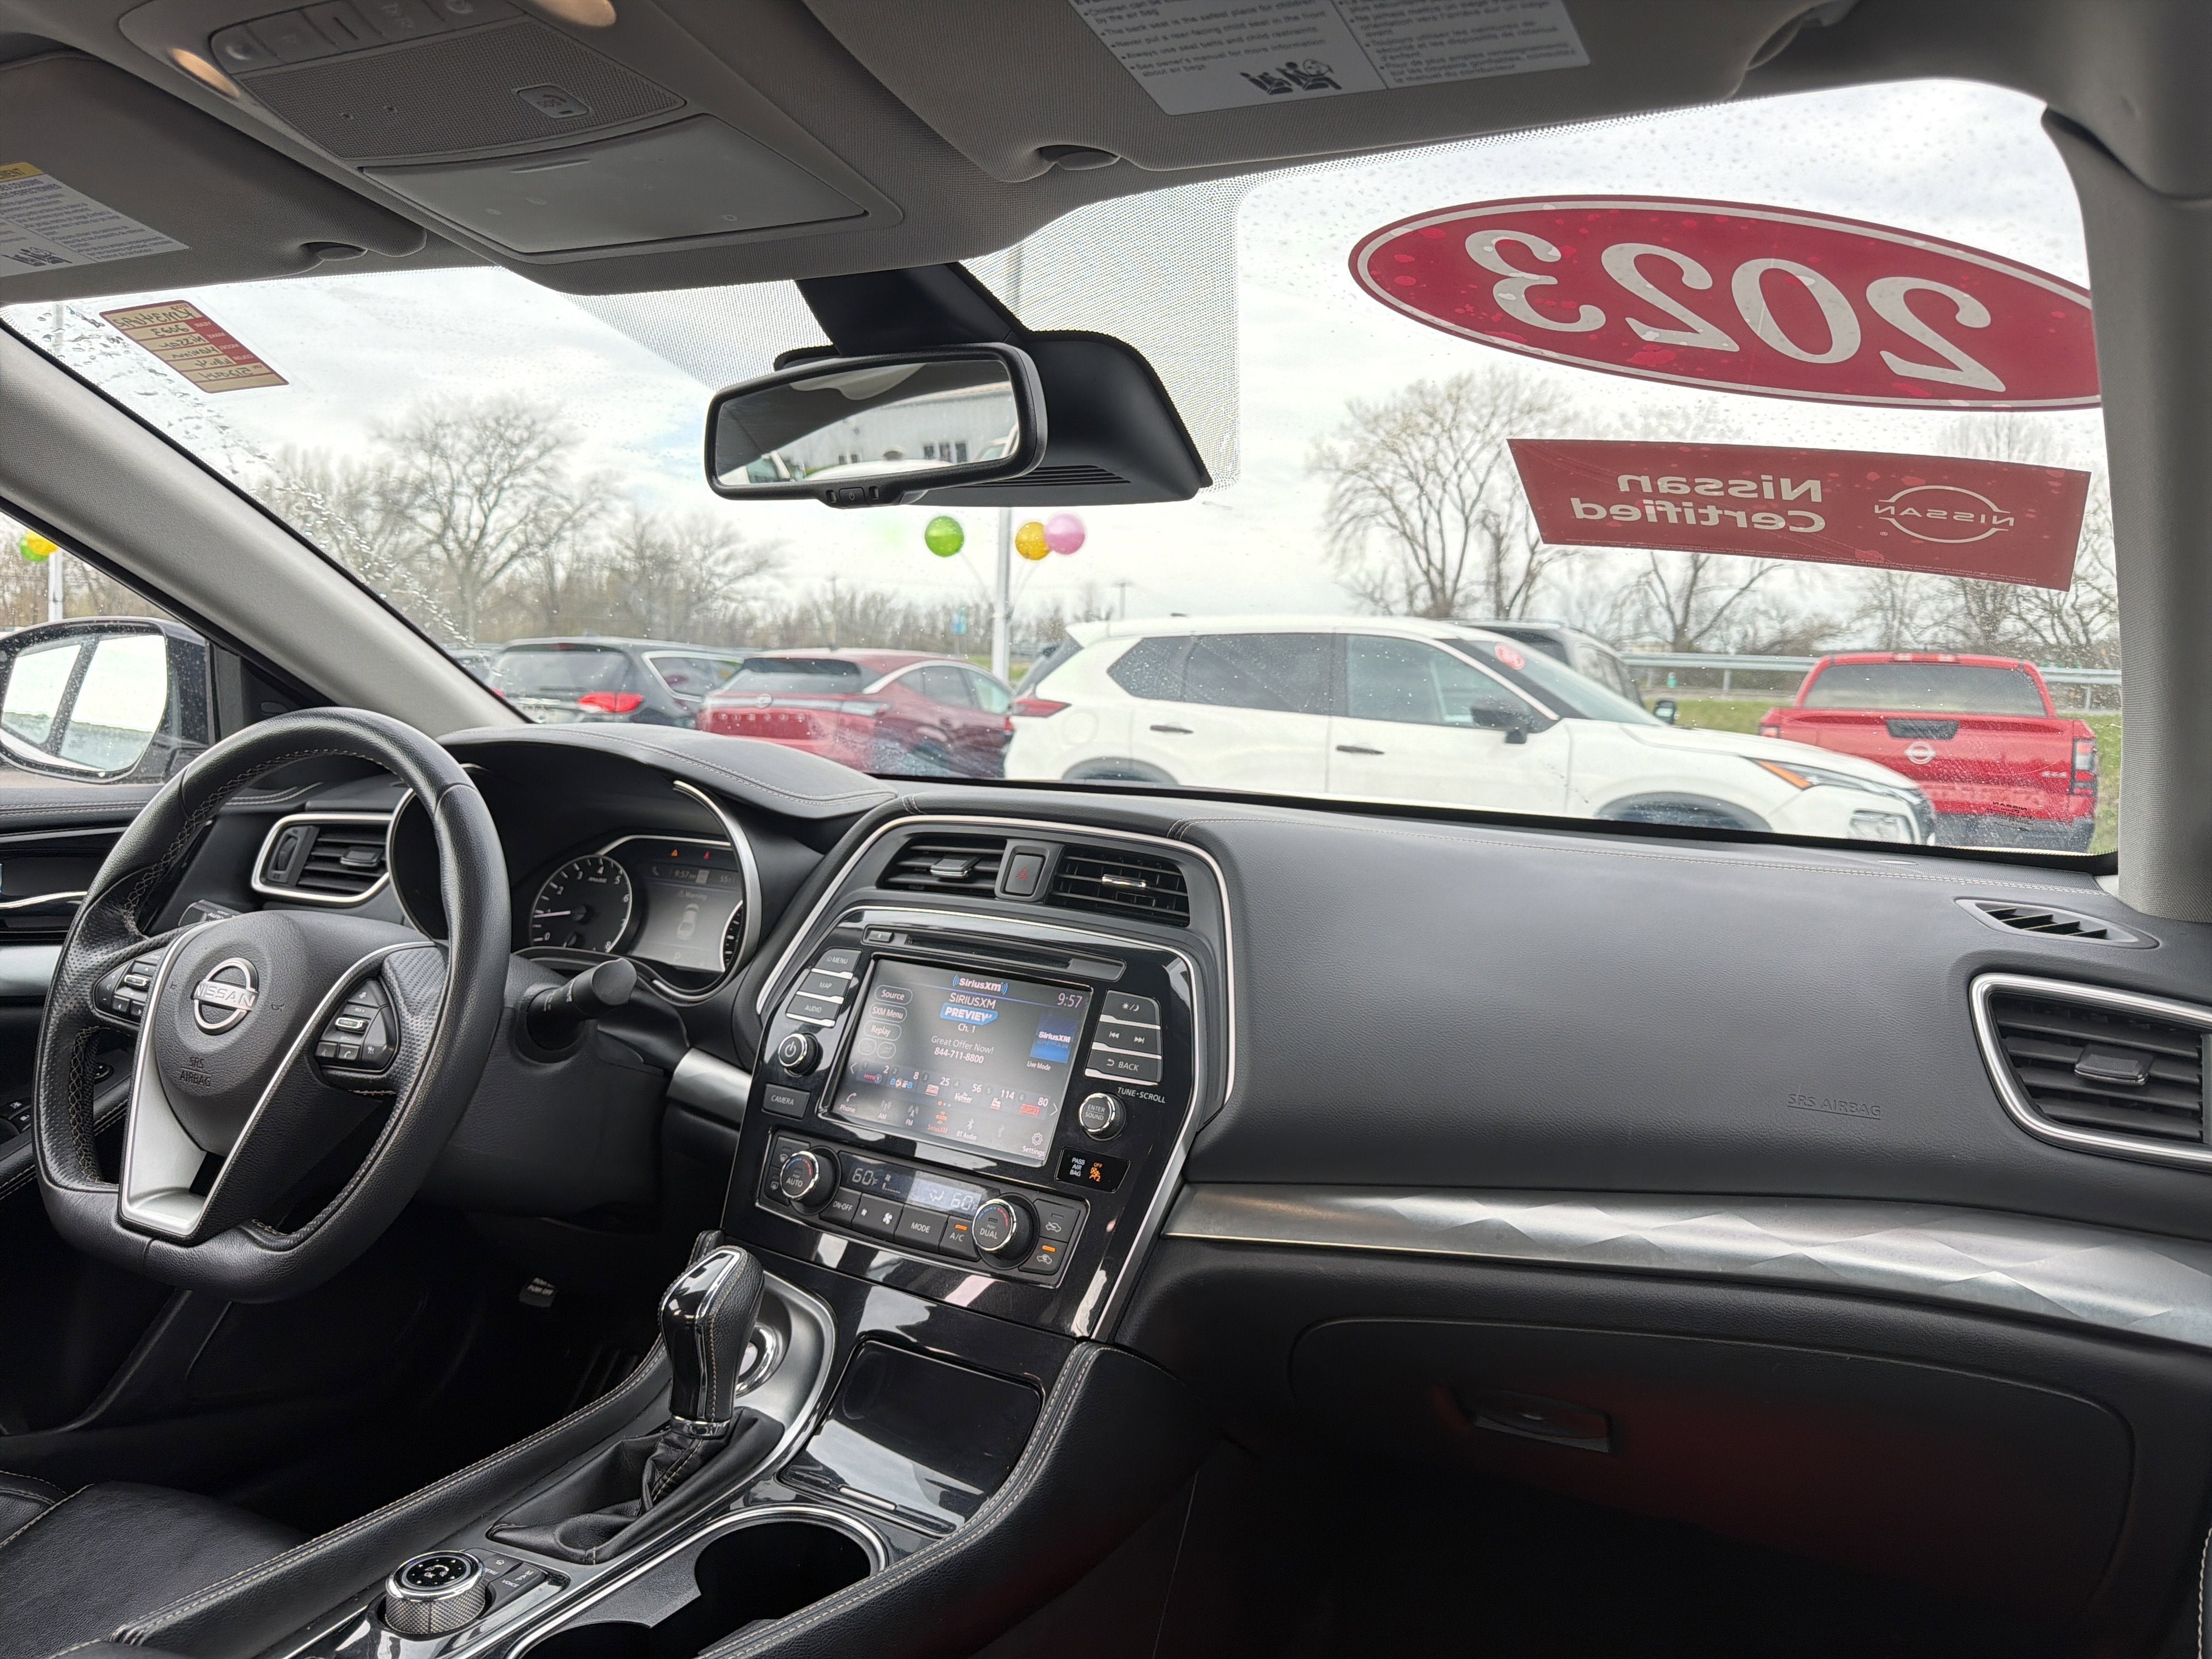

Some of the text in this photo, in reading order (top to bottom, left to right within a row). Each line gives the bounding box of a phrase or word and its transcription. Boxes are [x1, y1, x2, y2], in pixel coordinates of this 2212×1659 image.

[614, 875, 621, 884] 5
[557, 886, 564, 895] 2
[544, 932, 551, 941] 0
[832, 956, 849, 964] MENU
[194, 984, 256, 1007] NISSAN
[881, 989, 905, 1001] Source
[1057, 992, 1083, 1008] 9:57
[949, 992, 997, 1010] SIRIUSXM
[804, 1005, 822, 1013] AUDIO
[872, 1006, 904, 1019] SXM Menu
[944, 1006, 993, 1022] PREVIEW
[871, 1025, 891, 1037] Replay
[932, 1035, 995, 1054] Great Offer Now!
[934, 1047, 984, 1064] 844-711-8800
[883, 1065, 889, 1074] 2
[1037, 1063, 1051, 1071] Mode
[1118, 1061, 1139, 1072] BACK
[180, 1070, 211, 1087] AIRBAG
[913, 1071, 919, 1080] 8
[939, 1076, 951, 1086] 25
[972, 1083, 982, 1093] 56
[1001, 1089, 1015, 1100] 114
[771, 1095, 794, 1105] CAMERA
[1037, 1097, 1049, 1107] 80
[1788, 1093, 1881, 1117] SRS AIRBAG
[839, 1104, 856, 1113] Phone
[1087, 1104, 1105, 1113] ENTER
[1085, 1111, 1104, 1121] SOUND
[963, 1132, 977, 1141] Audio
[1022, 1145, 1045, 1158] Settings
[1071, 1157, 1086, 1166] PASS
[786, 1177, 803, 1187] AUTO
[911, 1222, 931, 1233] MODE
[949, 1232, 964, 1242] A/C
[980, 1227, 998, 1240] DUAL
[501, 1579, 520, 1588] VOICE
